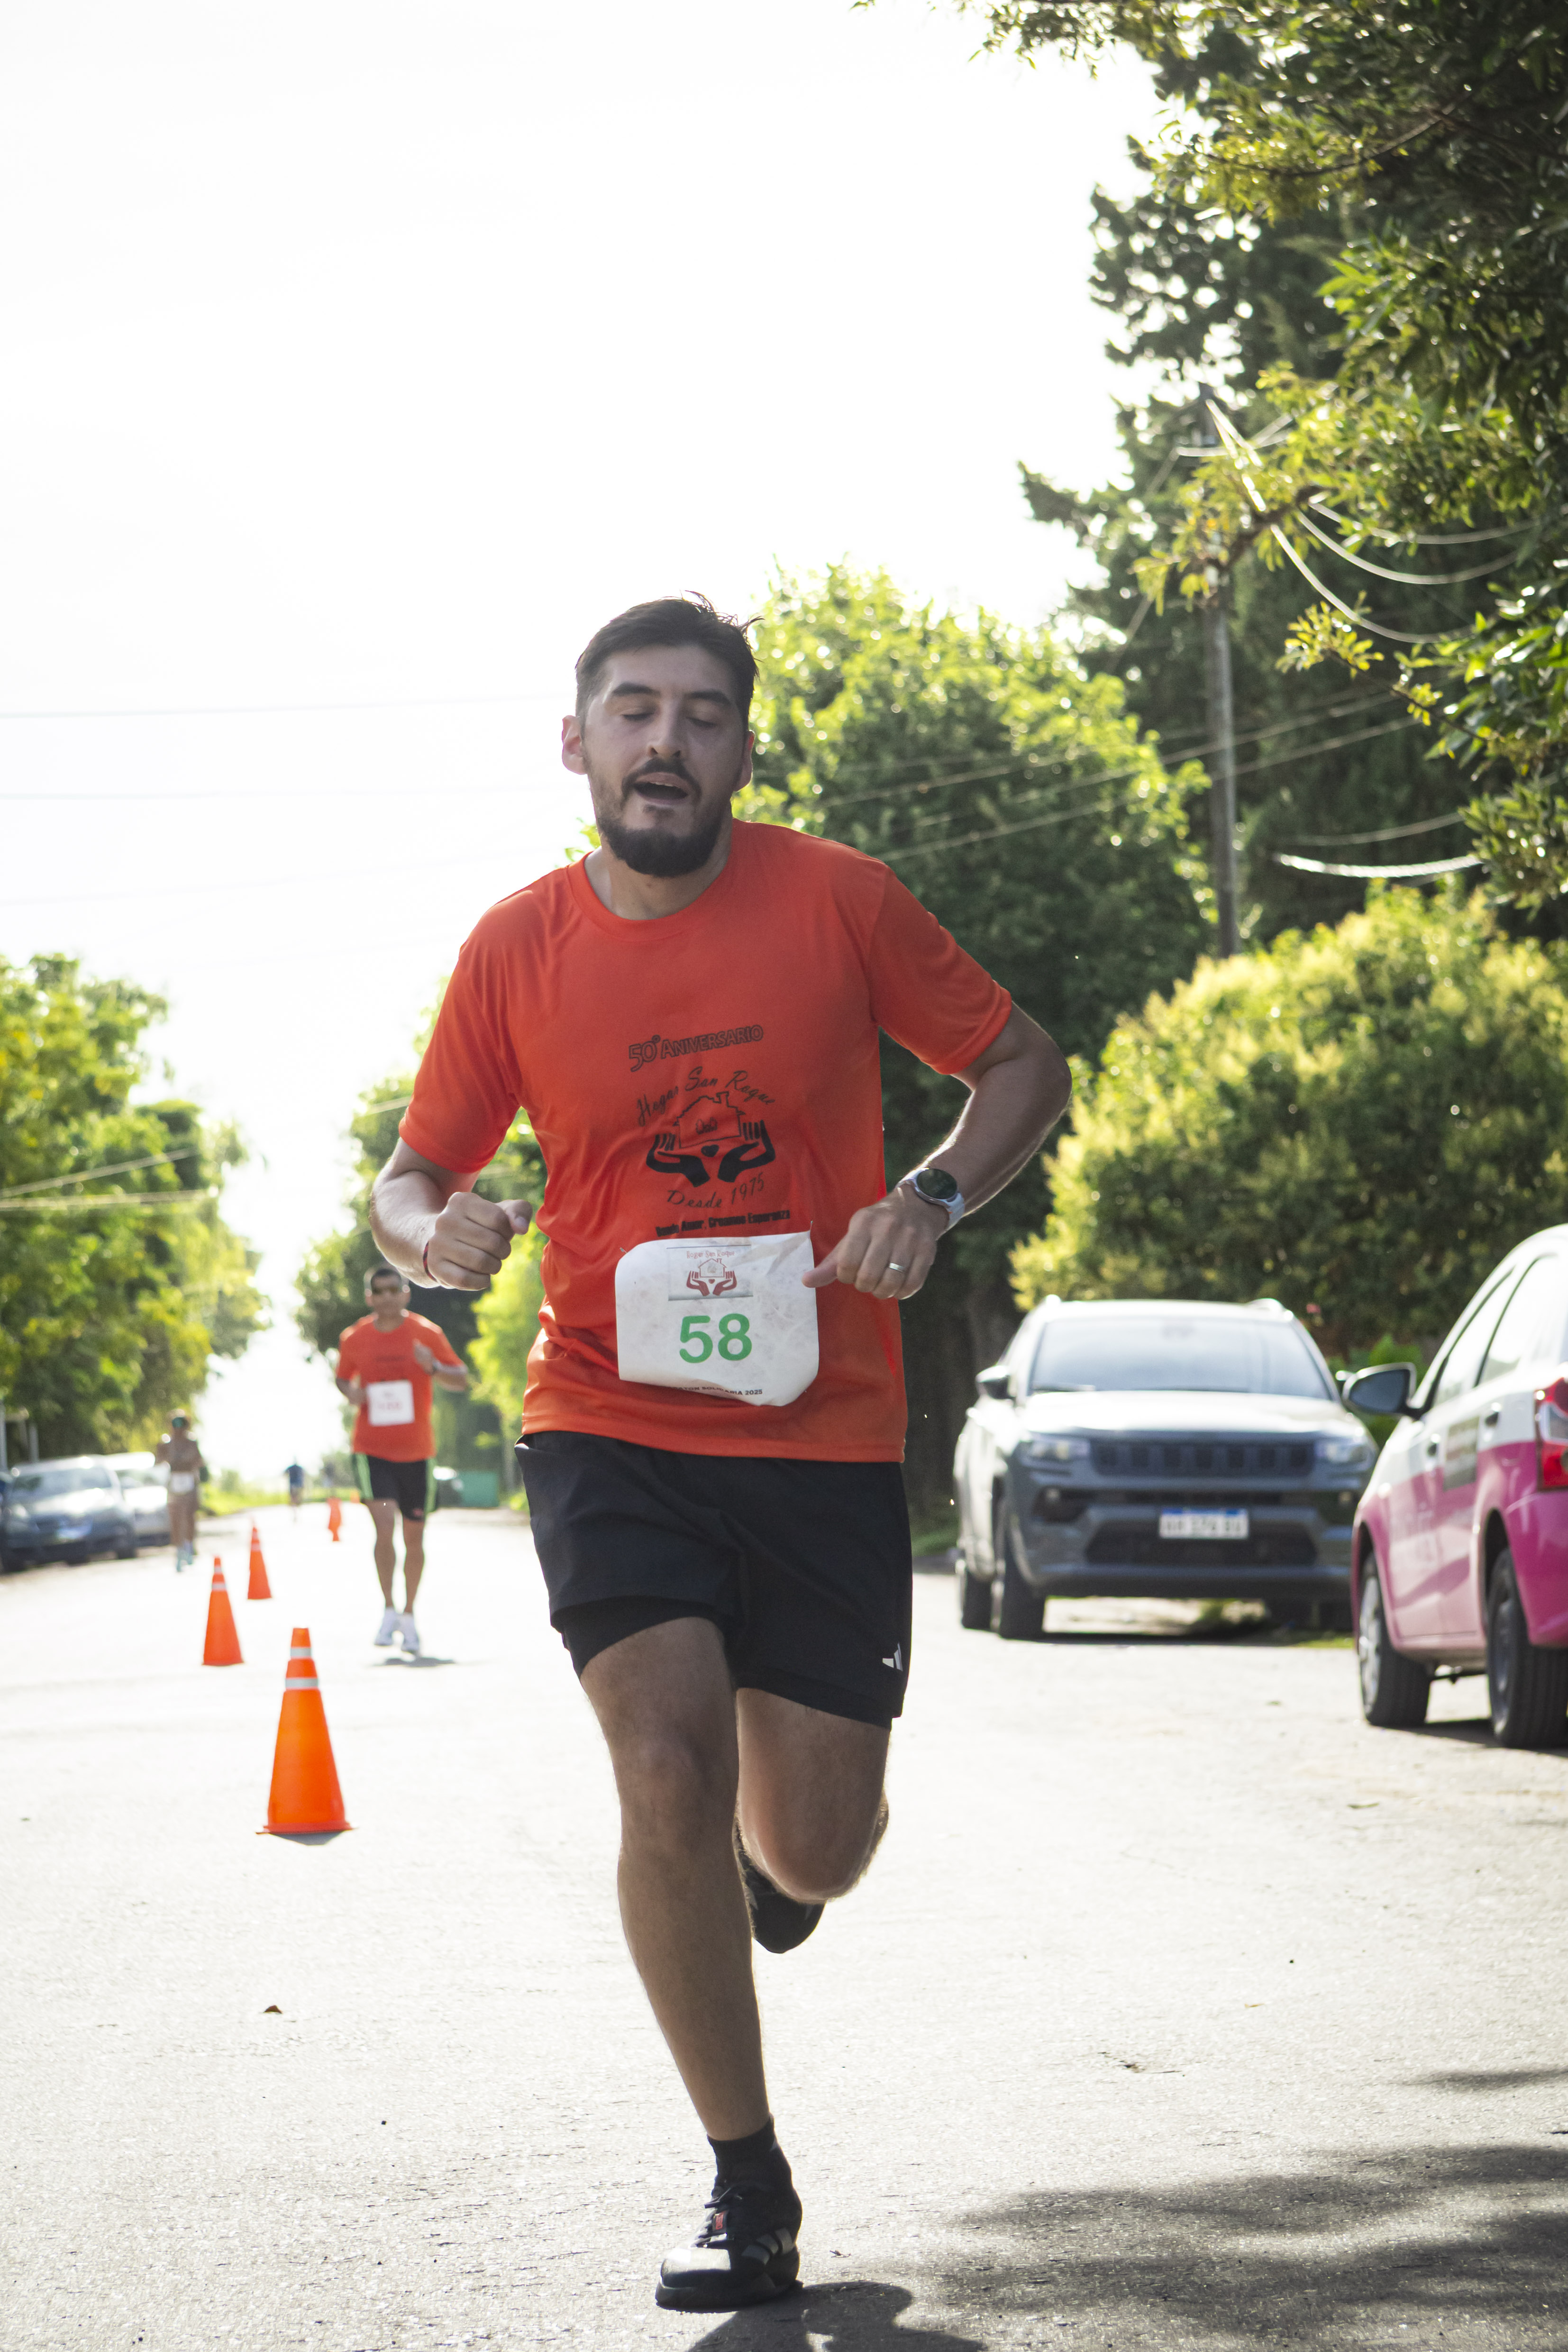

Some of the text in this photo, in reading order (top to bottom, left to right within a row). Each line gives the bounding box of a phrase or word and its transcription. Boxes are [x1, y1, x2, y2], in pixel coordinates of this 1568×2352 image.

[661, 1024, 764, 1060] ANIVERSARIO
[637, 1066, 776, 1127] Hogar San Roque
[666, 1172, 765, 1208] Desde 1975
[686, 1249, 735, 1259] Hogar San Roque
[679, 1313, 752, 1364] 58
